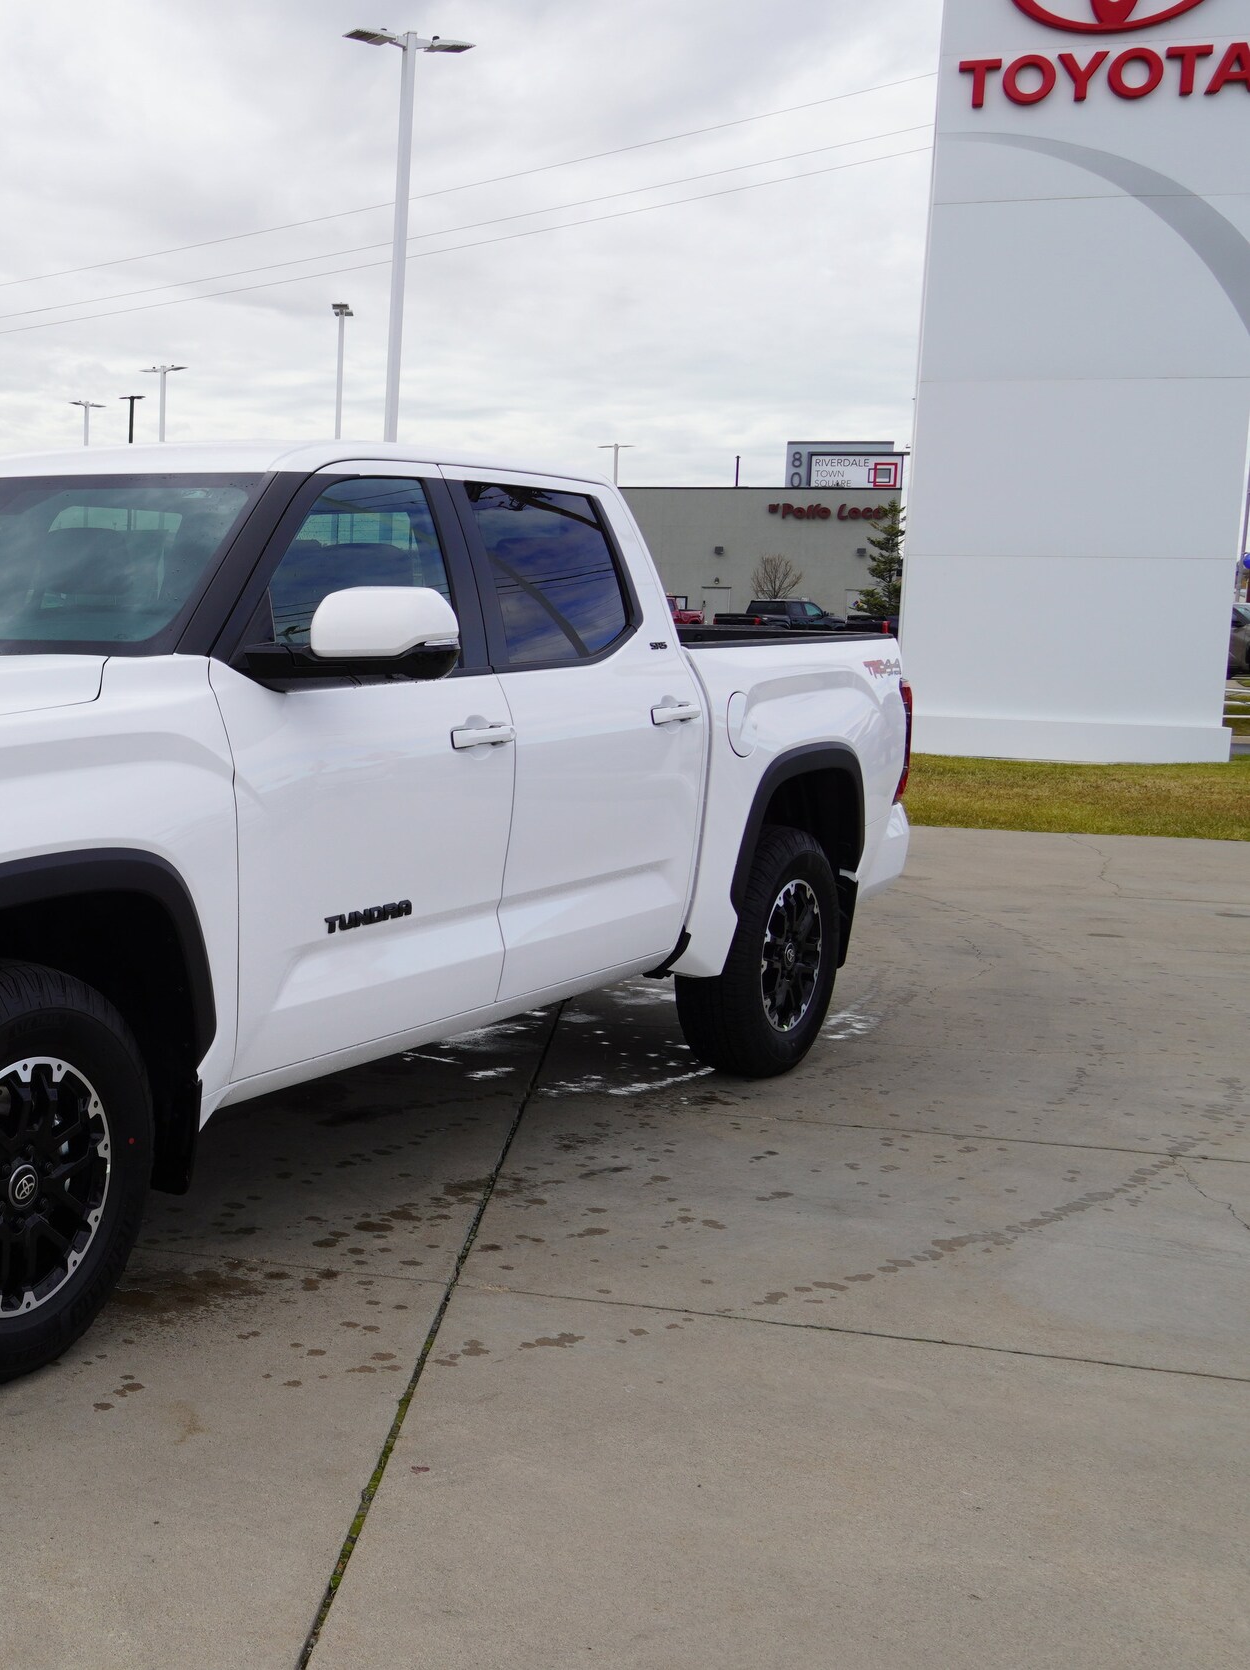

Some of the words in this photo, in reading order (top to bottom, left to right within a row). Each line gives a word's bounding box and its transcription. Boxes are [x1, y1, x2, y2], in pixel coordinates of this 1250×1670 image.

[958, 42, 1250, 109] TOYOTA
[814, 458, 870, 468] RIVERDALE
[814, 469, 845, 478] TOWN
[814, 480, 852, 488] SQUARE
[781, 502, 832, 520] Pollo
[324, 899, 412, 934] TUNDRA
